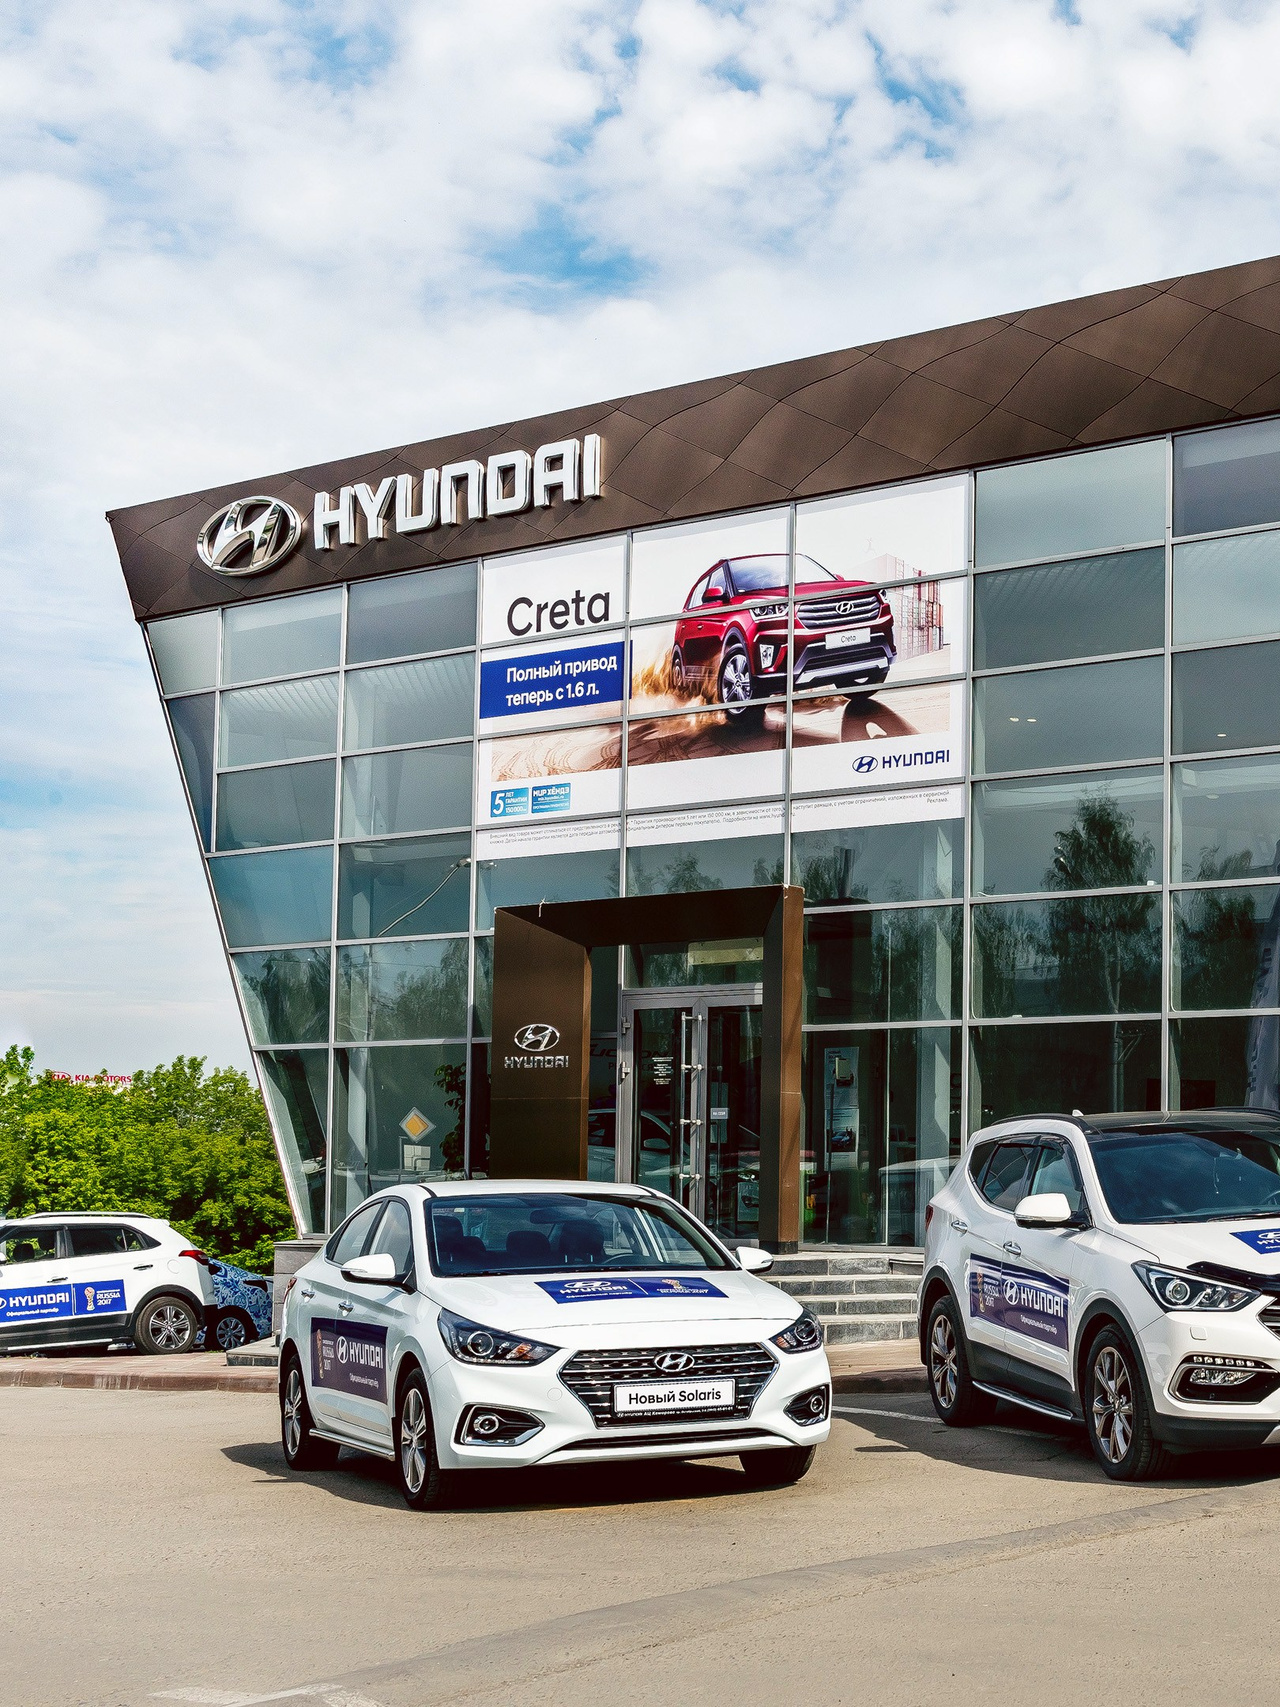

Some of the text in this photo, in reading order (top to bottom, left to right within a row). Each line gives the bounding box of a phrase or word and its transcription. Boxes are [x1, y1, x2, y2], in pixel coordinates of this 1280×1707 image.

[314, 434, 602, 550] HYUNDAI
[506, 590, 611, 637] Creta
[506, 656, 618, 683] Полный привод
[506, 681, 600, 706] теперь с 1.6 л.
[881, 749, 950, 770] HYUNDAI
[493, 793, 505, 815] 5
[504, 1055, 570, 1069] HYUNDAI
[74, 1074, 91, 1082] KIA
[9, 1292, 70, 1308] HYUNDAI
[96, 1292, 121, 1300] RUSSIA
[560, 1285, 627, 1294] HYUNDAI
[1020, 1286, 1065, 1318] HYUNDAI
[349, 1341, 384, 1369] HYUNDAI
[628, 1388, 722, 1405] Новый Solaris
